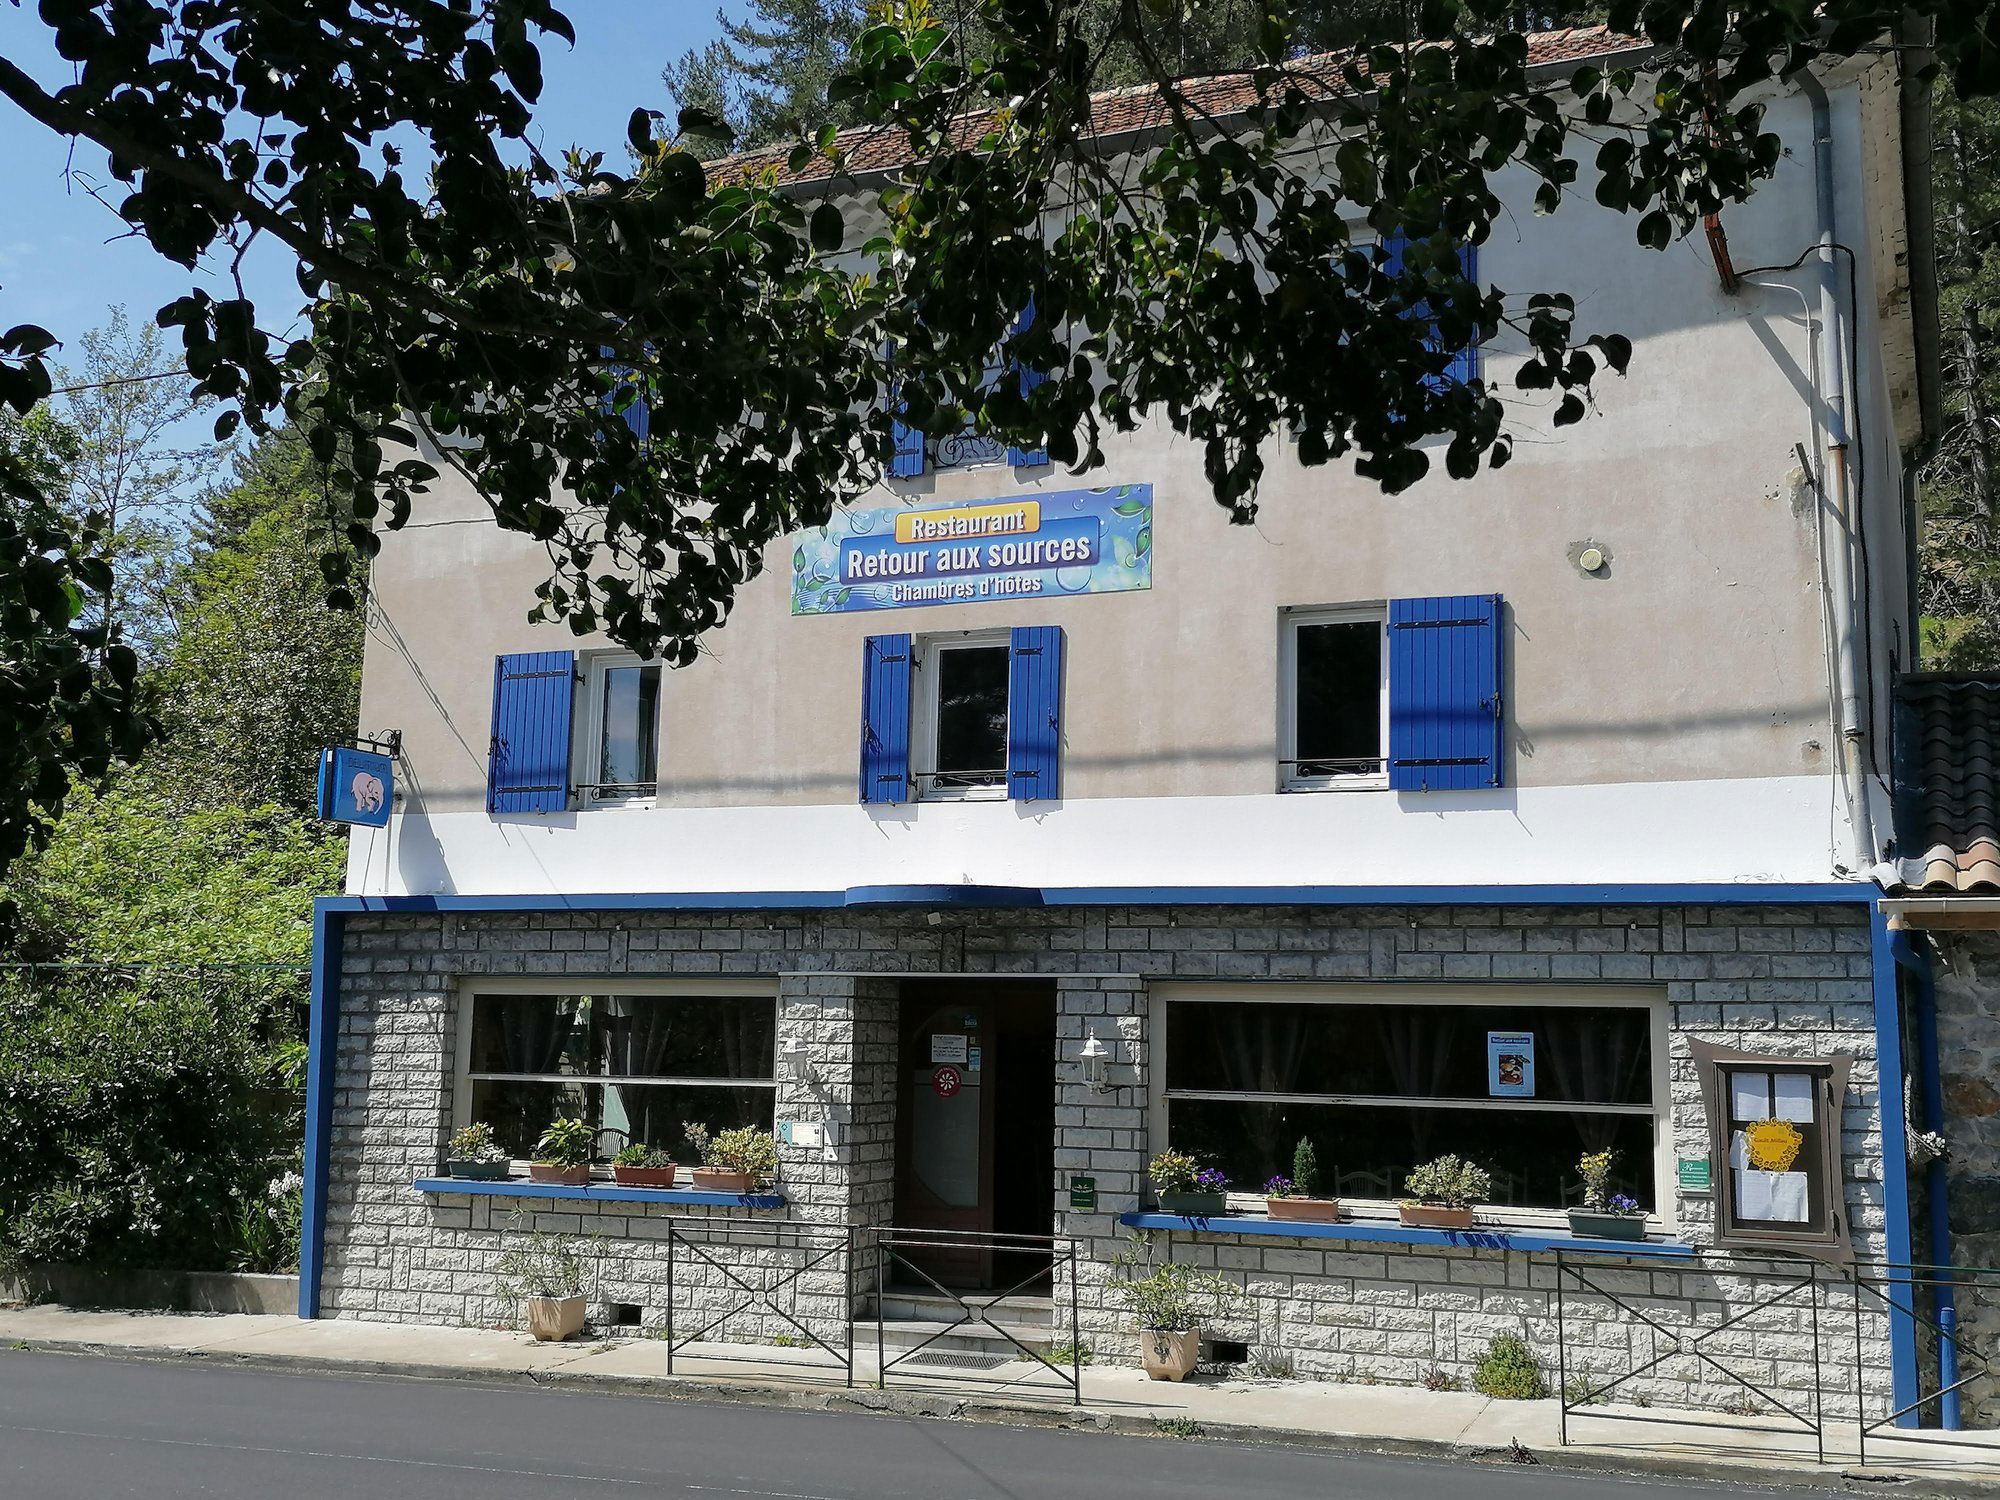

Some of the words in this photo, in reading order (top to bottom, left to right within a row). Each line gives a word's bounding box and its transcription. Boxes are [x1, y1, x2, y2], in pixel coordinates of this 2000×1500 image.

[911, 509, 1025, 539] Restaurant
[848, 548, 929, 578] Retour
[936, 546, 981, 571] aux
[987, 536, 1091, 567] sources
[892, 581, 975, 602] Chambres
[979, 576, 1042, 596] d'hôtes
